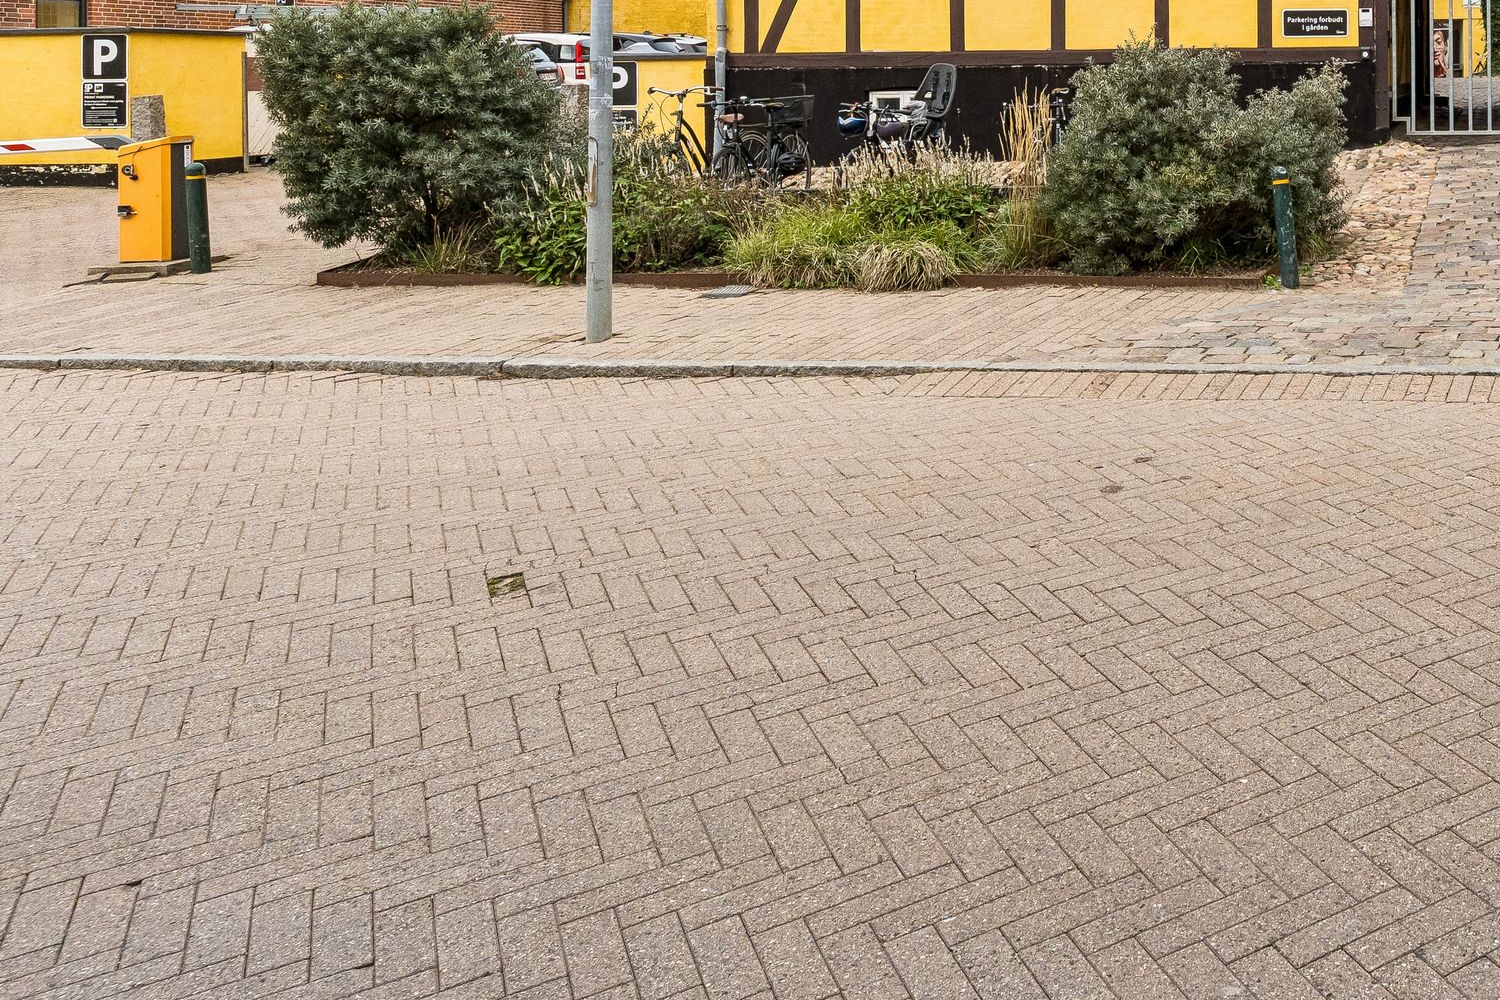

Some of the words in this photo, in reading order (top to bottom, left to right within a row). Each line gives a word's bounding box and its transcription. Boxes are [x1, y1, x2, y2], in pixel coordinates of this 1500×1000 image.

[1287, 16, 1318, 24] Parkering
[1305, 24, 1329, 32] gården
[93, 39, 118, 76] P
